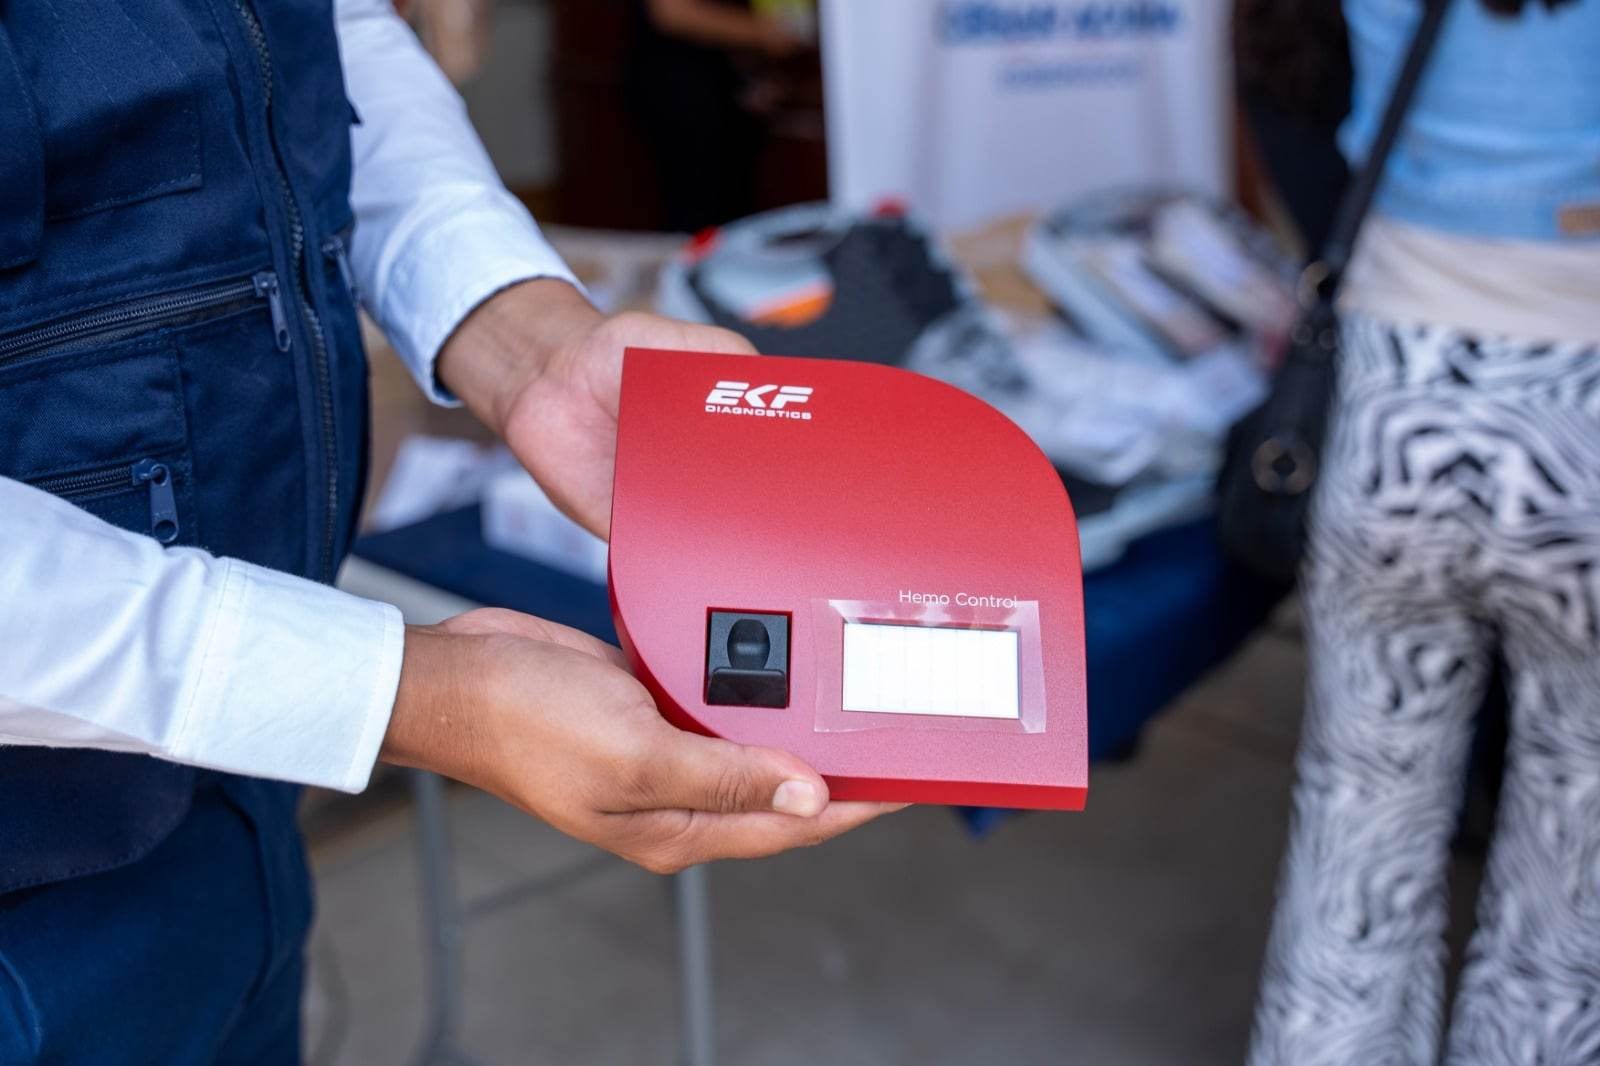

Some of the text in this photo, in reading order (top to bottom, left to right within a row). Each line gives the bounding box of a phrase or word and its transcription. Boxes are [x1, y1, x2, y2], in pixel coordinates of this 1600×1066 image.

[705, 381, 813, 409] EKF
[705, 405, 812, 420] DIAGNOSTICS
[899, 590, 1017, 609] Hemo Control
